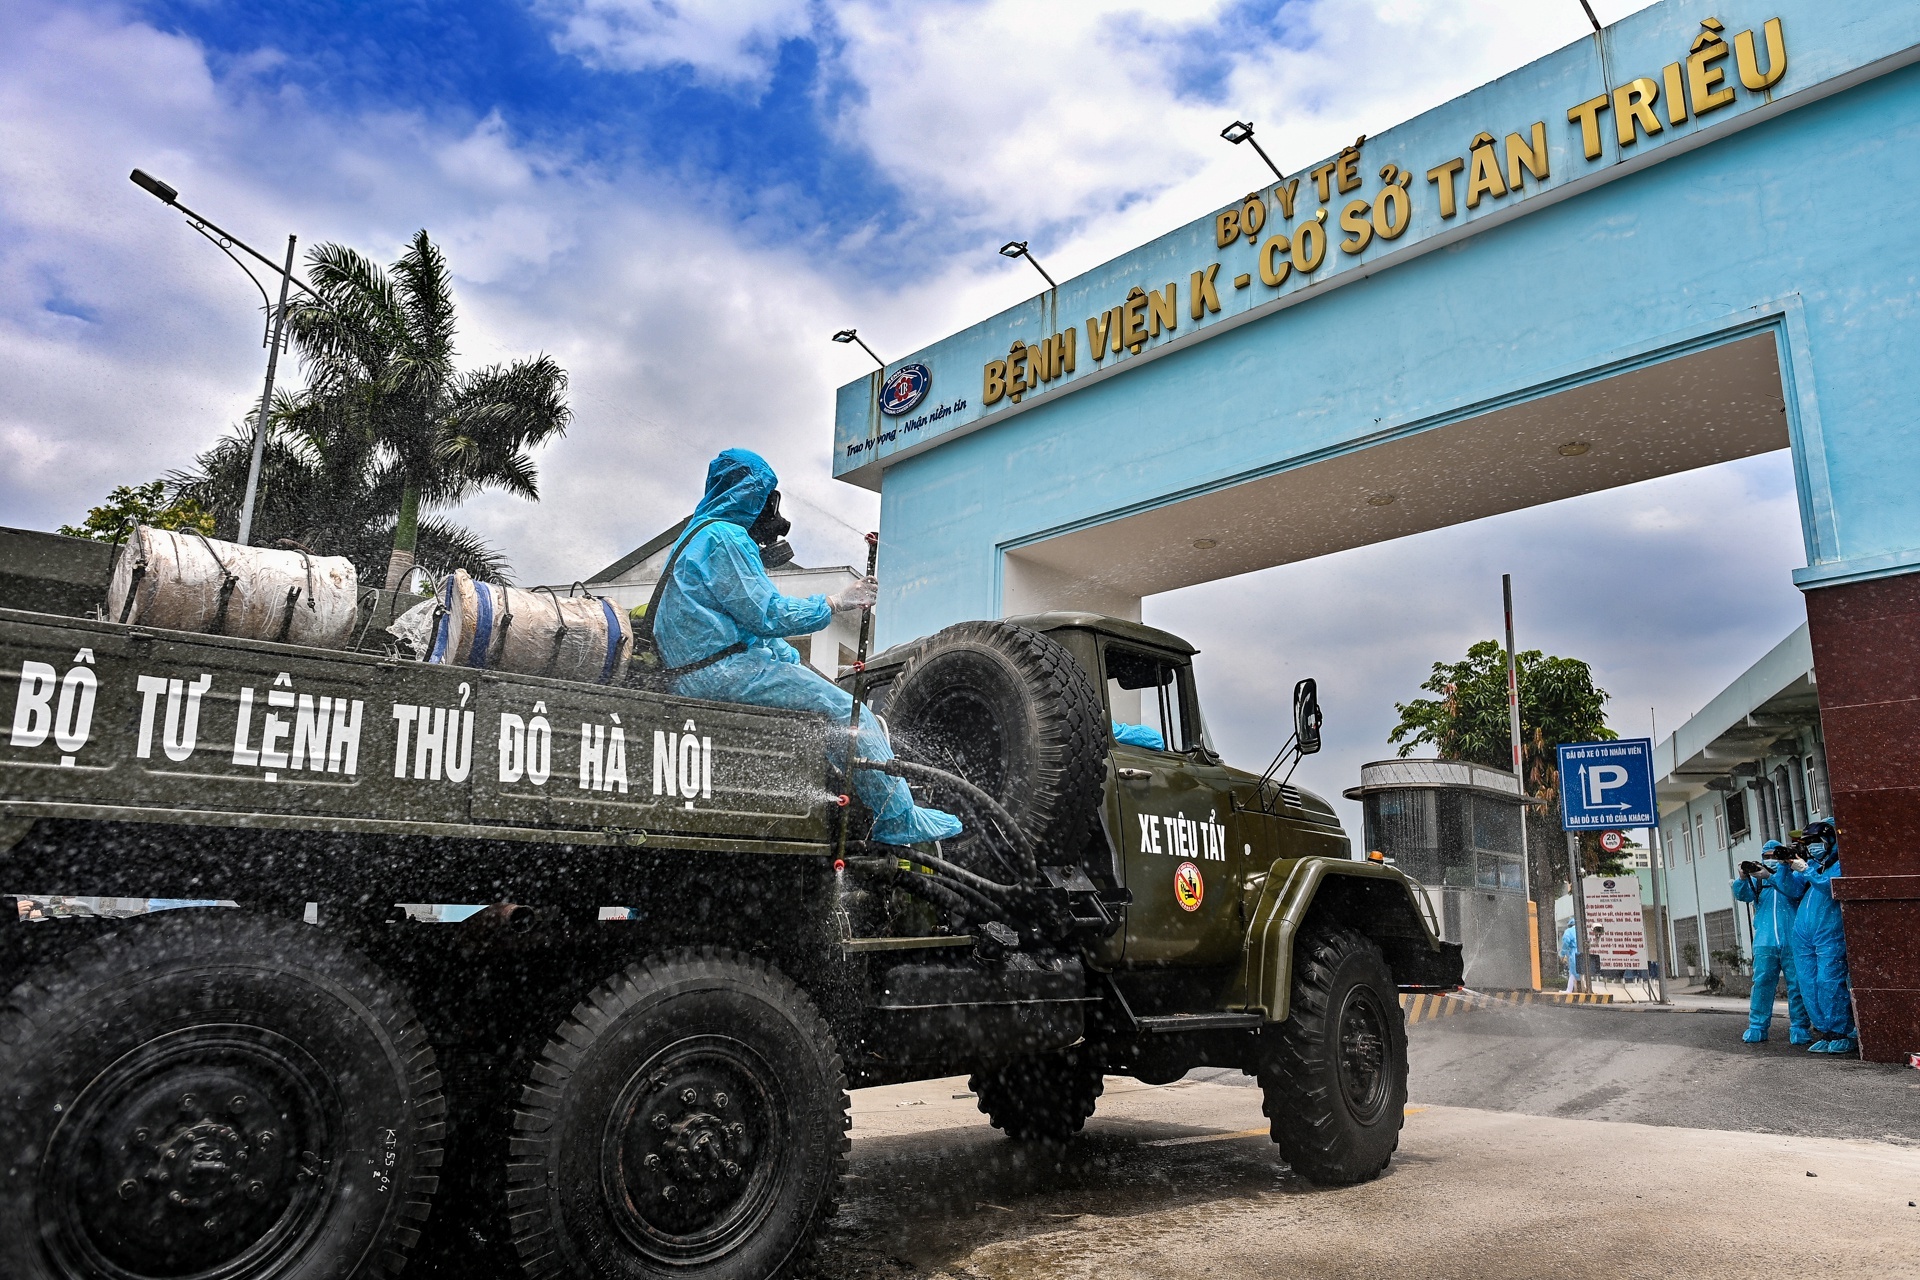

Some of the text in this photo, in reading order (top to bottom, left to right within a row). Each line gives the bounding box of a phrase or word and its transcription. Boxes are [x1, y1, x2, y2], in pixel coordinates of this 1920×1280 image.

[983, 339, 1076, 406] BỆNH
[1086, 282, 1177, 361] VIỆN
[1190, 263, 1221, 320] K
[1258, 207, 1328, 287] CƠ
[1339, 163, 1413, 254] SỞ
[1427, 121, 1550, 220] TÂN
[1567, 16, 1788, 162] TRIỀU
[1216, 134, 1367, 249] BỘ Y TẾ
[846, 443, 864, 457] Trao
[865, 438, 876, 451] hy
[877, 429, 897, 446] vọng
[904, 415, 928, 434] Nhận
[929, 404, 952, 424] niềm
[10, 648, 712, 810] BỘ TƯ LỆNH THỦ ĐÔ HÀ NỘI
[1586, 750, 1594, 758] XE
[1588, 765, 1628, 804] P
[1137, 808, 1226, 862] XE TIÊU TẨY
[1591, 815, 1599, 823] XE
